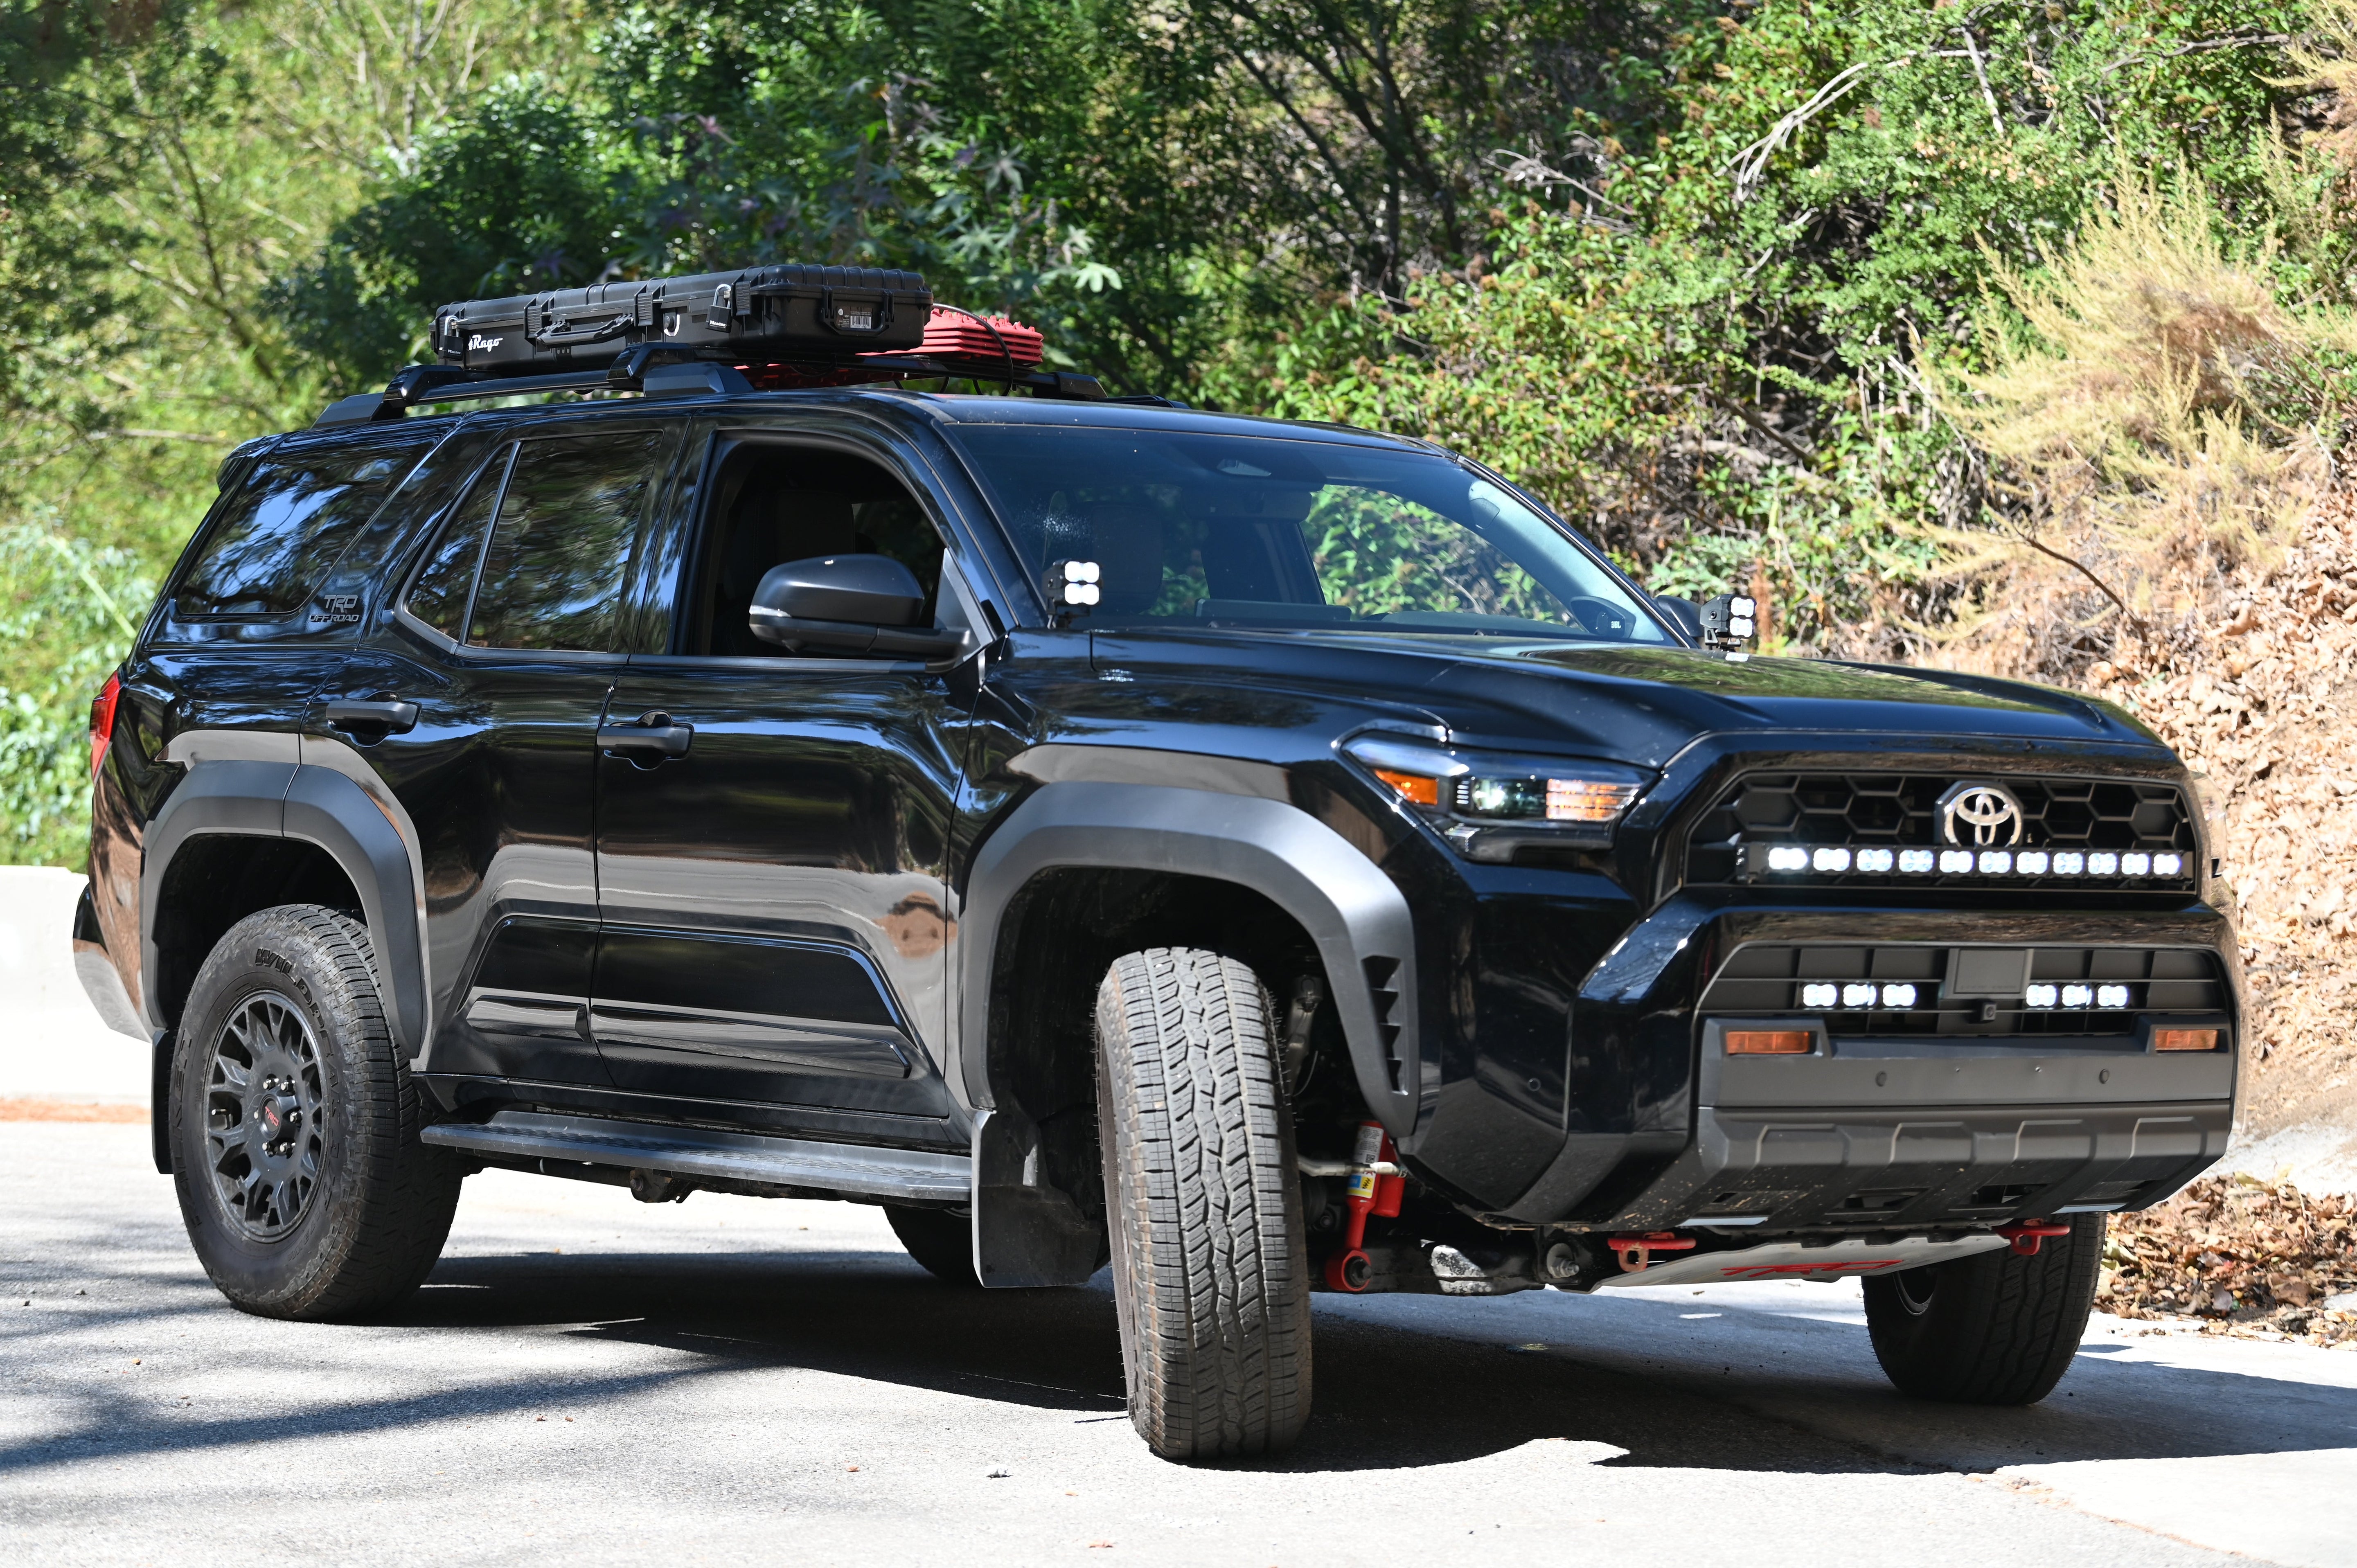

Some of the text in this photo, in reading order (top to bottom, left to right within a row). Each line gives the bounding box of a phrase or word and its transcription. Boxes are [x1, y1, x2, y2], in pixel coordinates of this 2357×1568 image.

[473, 334, 503, 352] Rago
[324, 595, 358, 613] TRD
[255, 947, 341, 1124] WILDPEAK
[265, 1106, 279, 1126] TRD
[1720, 1259, 1904, 1278] TRD
